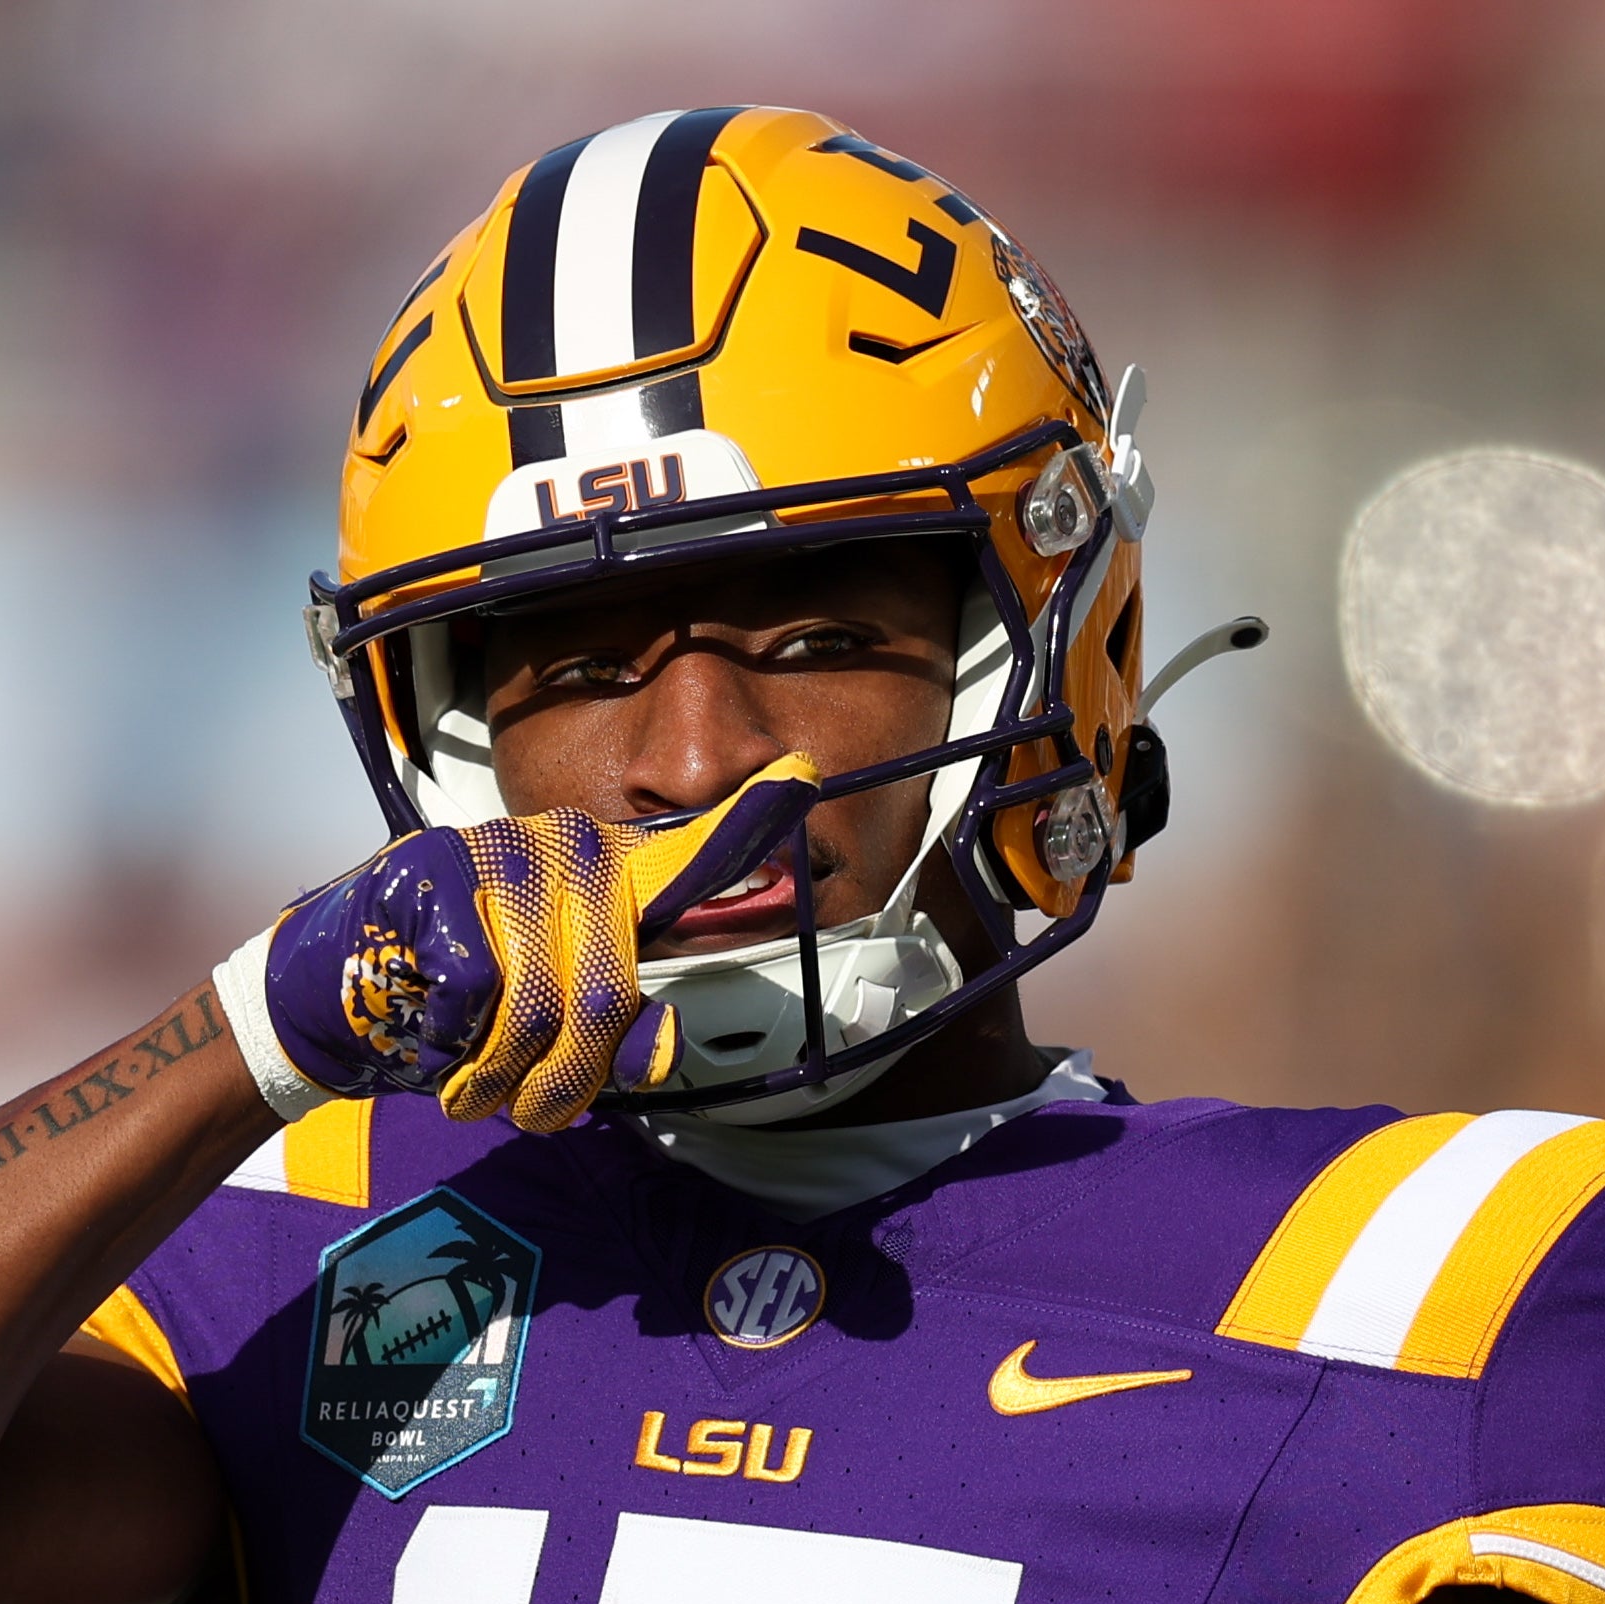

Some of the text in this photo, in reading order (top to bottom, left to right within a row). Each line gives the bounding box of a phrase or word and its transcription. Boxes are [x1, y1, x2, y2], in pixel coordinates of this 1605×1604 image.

[534, 453, 687, 528] LSU
[712, 1250, 820, 1339] SEC
[319, 1399, 475, 1423] RELIAQUEST
[371, 1430, 426, 1447] BOWL
[407, 1453, 427, 1463] BAY
[634, 1410, 813, 1483] LSU
